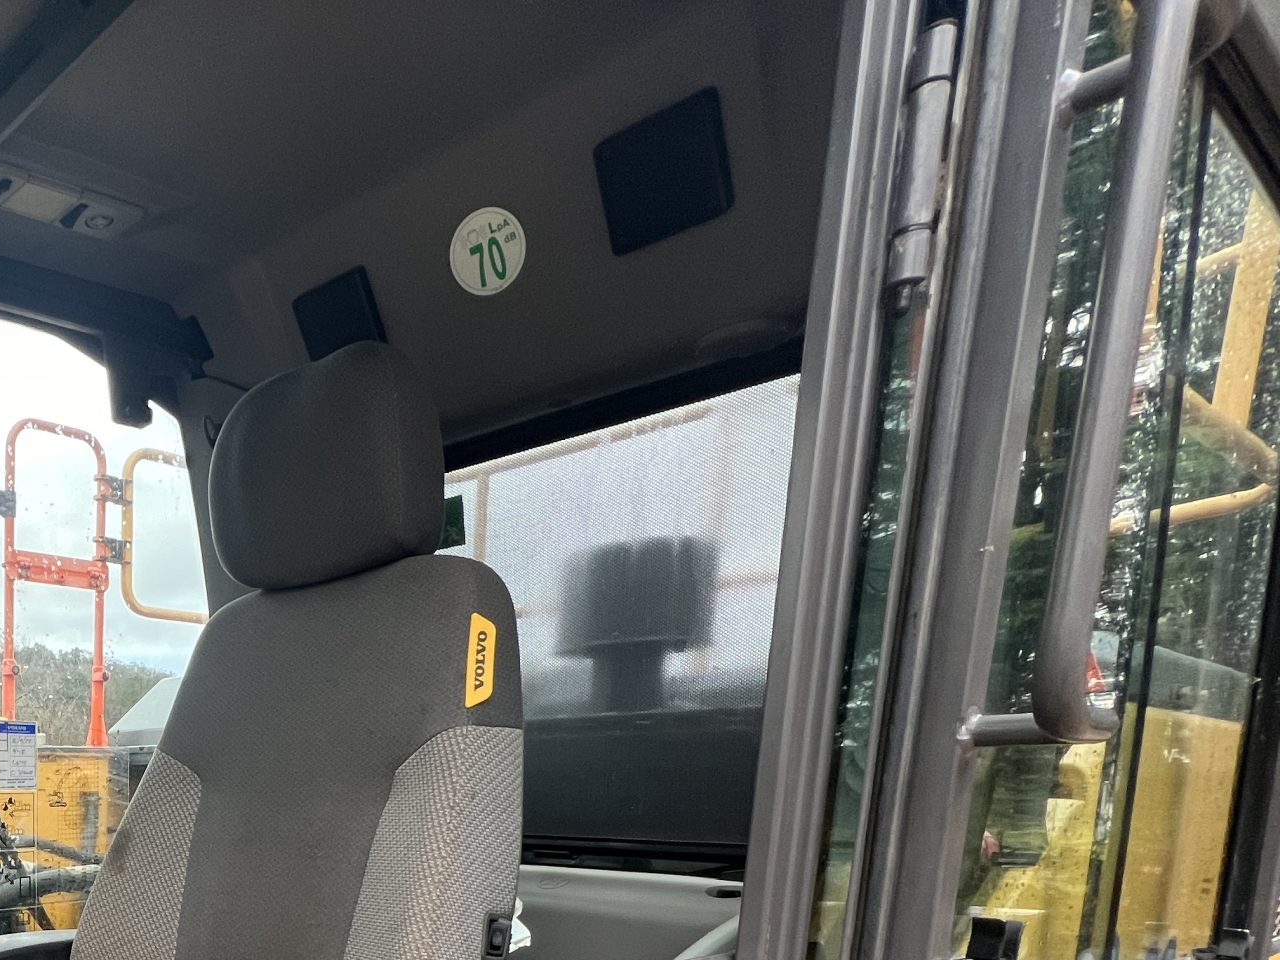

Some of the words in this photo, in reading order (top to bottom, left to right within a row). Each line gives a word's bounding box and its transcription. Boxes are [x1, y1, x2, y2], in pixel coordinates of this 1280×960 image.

[469, 236, 507, 288] 70
[504, 231, 517, 244] dB
[474, 630, 488, 692] VOLVO
